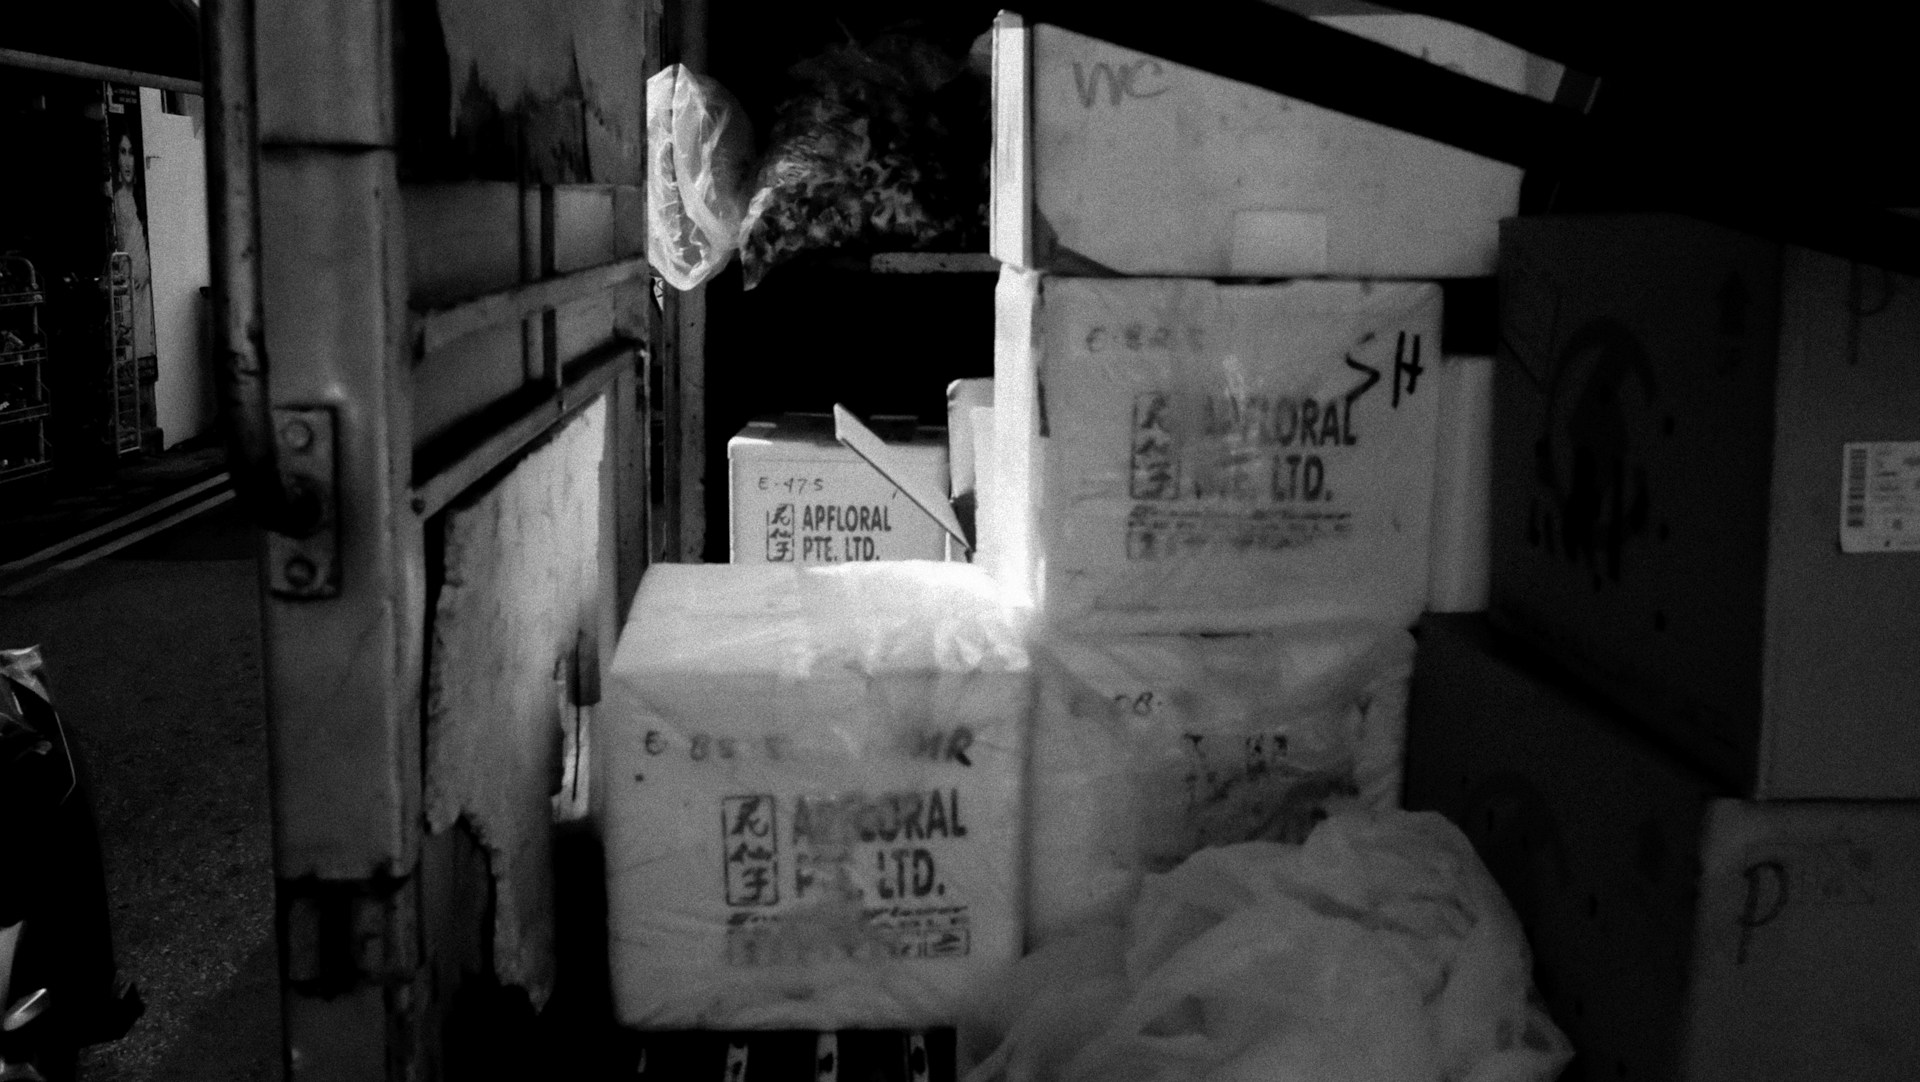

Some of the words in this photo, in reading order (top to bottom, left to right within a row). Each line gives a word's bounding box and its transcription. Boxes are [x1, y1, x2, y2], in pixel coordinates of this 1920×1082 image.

[803, 505, 891, 531] APFLORAL
[803, 536, 838, 562] PTE.
[845, 536, 880, 562] LTD.
[793, 788, 967, 845] ALORAL
[877, 847, 946, 900] LTD.
